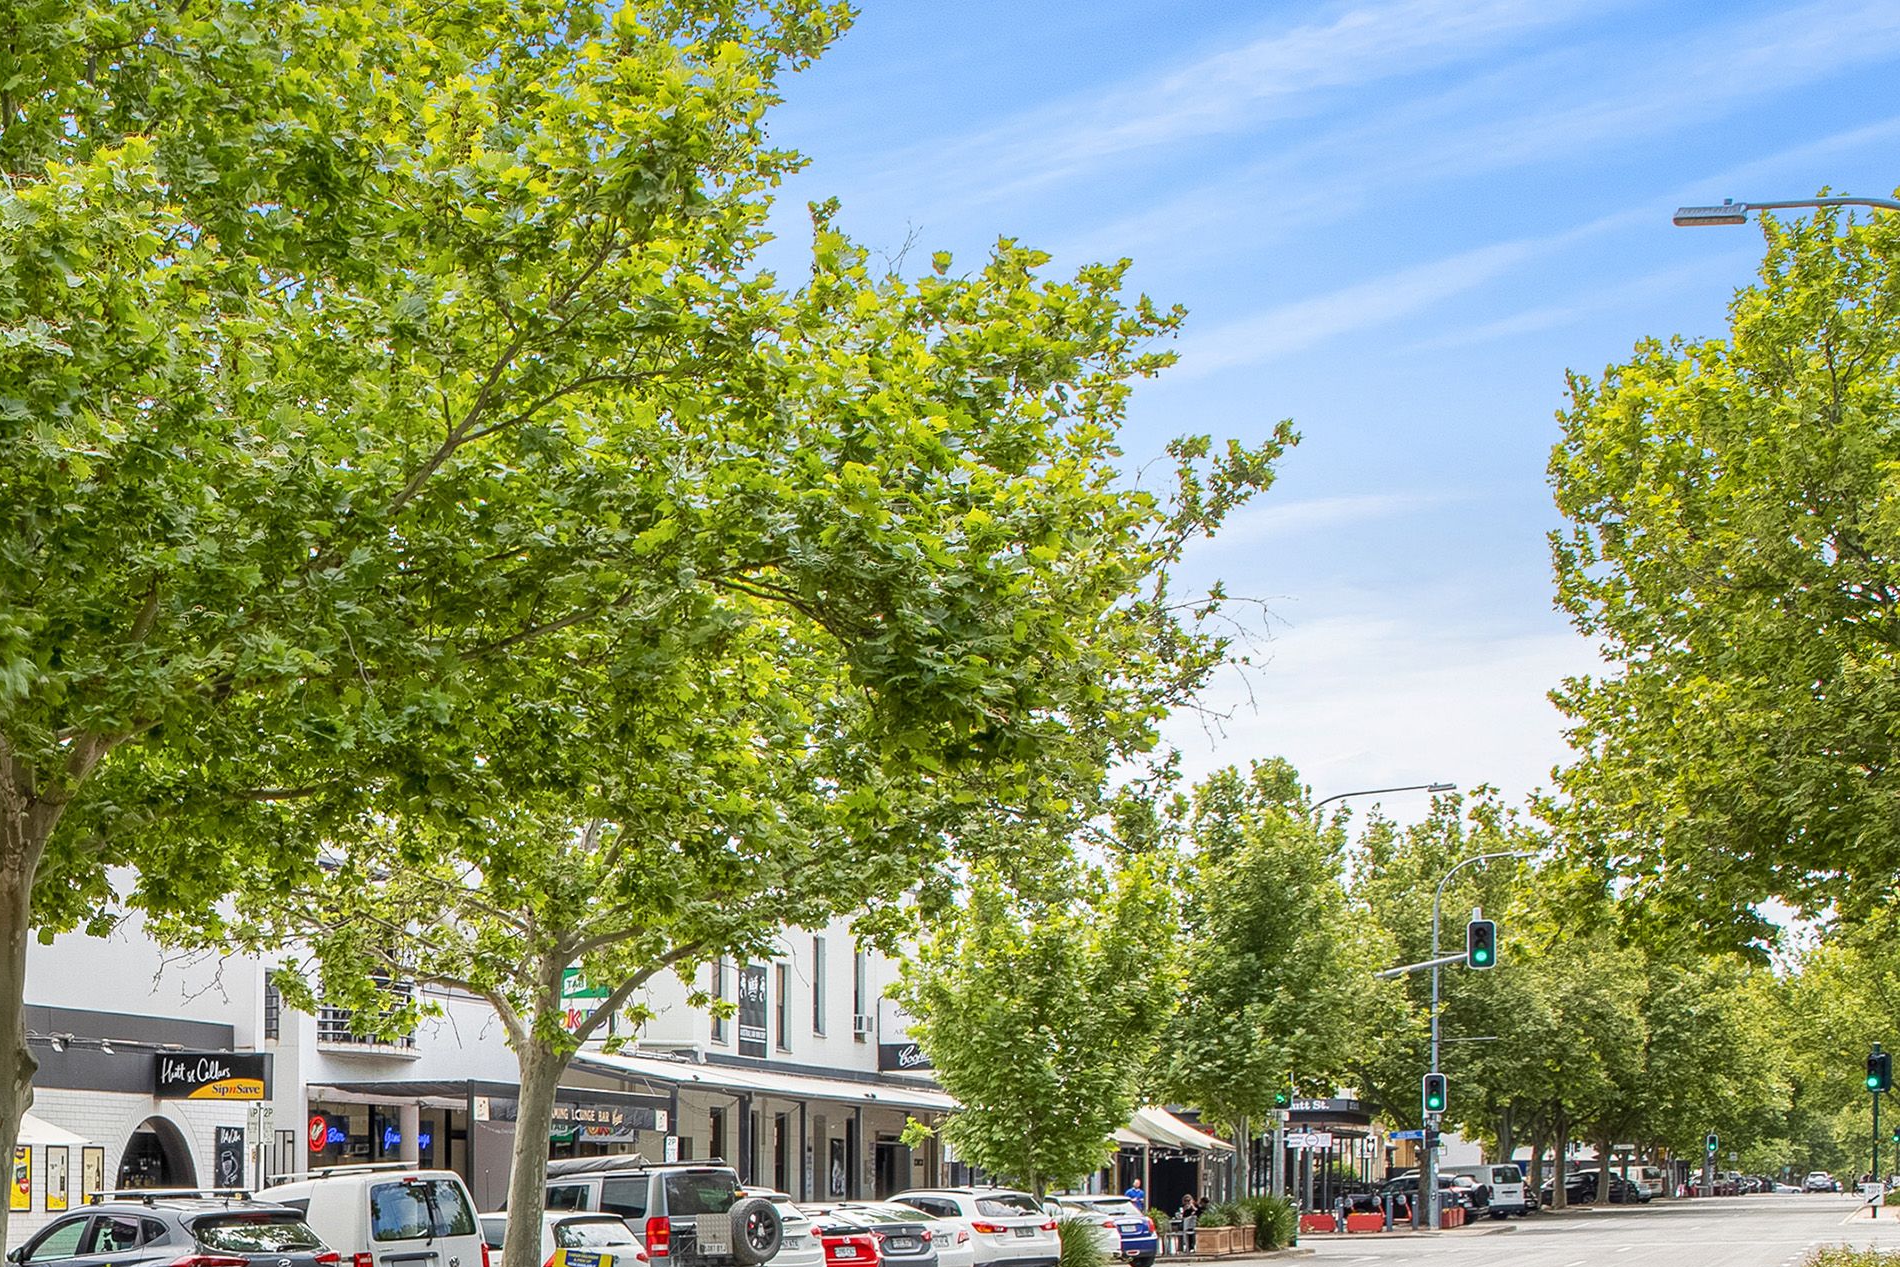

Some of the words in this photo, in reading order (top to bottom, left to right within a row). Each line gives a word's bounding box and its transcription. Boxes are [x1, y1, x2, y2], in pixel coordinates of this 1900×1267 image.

[197, 1058, 231, 1082] Cellars
[1290, 1101, 1311, 1110] utt
[263, 1108, 274, 1117] 2P
[571, 1108, 596, 1122] LOUNGE
